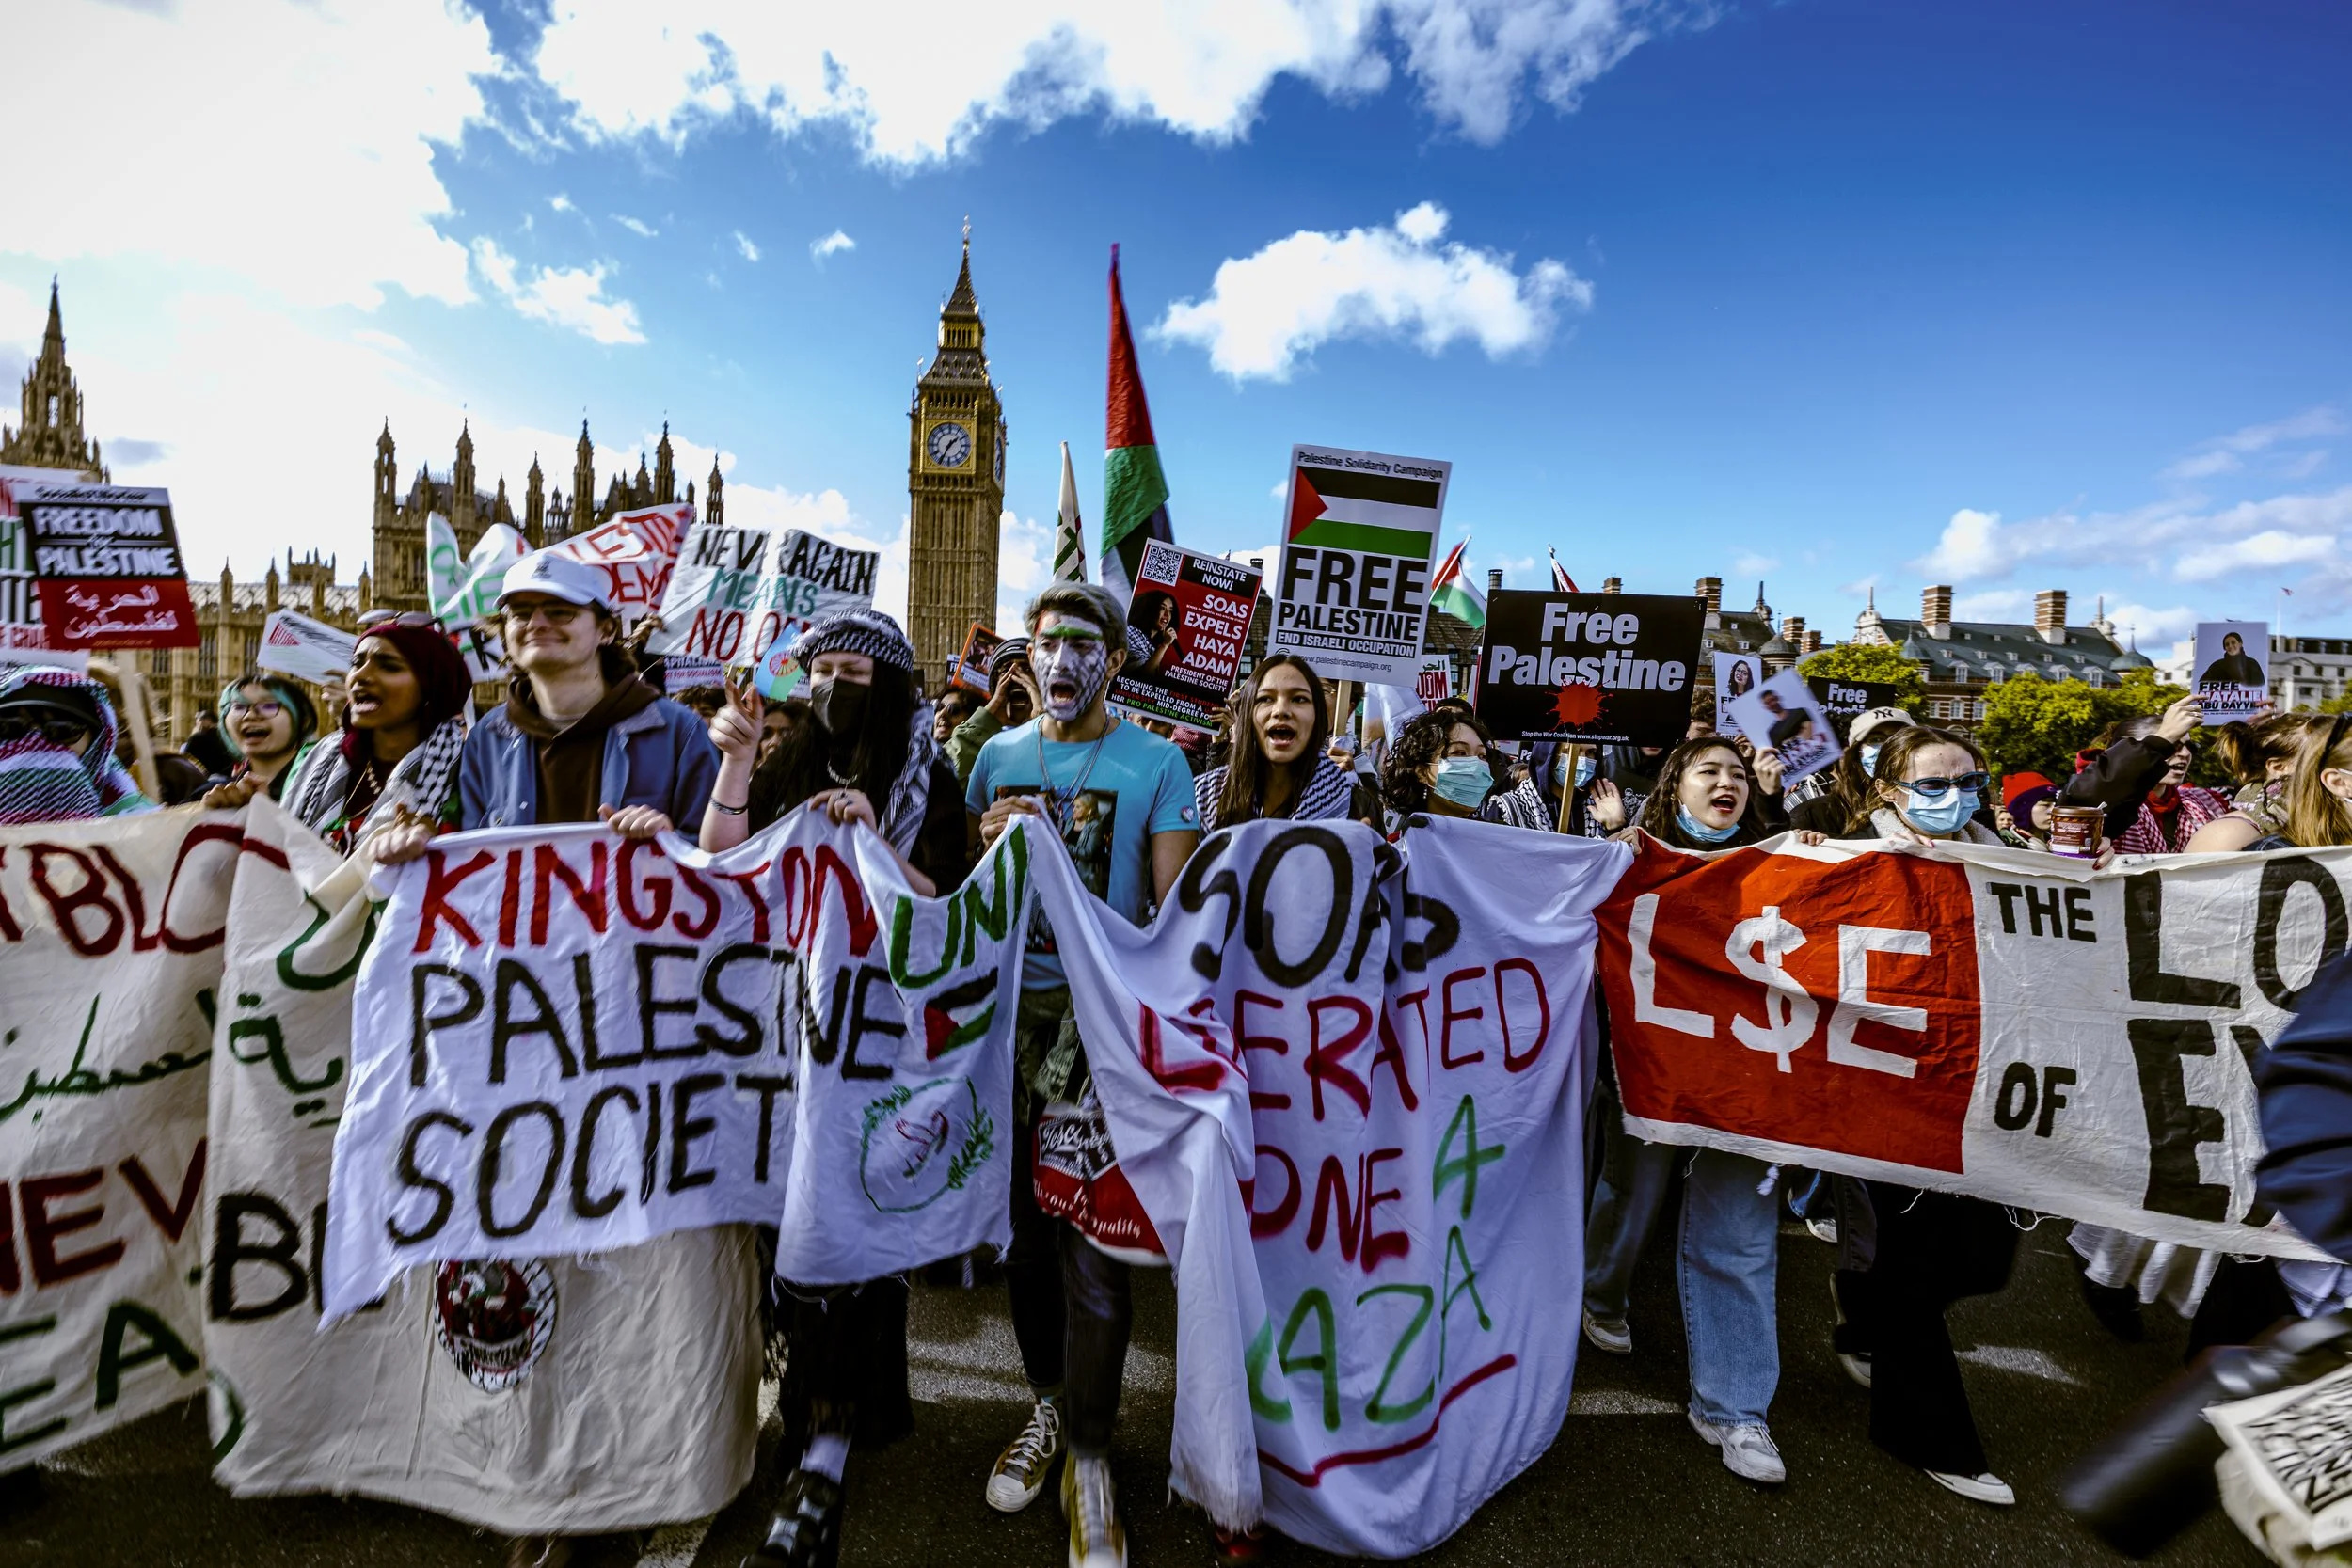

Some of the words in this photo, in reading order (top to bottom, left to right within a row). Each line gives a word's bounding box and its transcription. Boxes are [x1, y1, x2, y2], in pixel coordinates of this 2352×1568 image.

[1297, 451, 1343, 468] Palestine
[1345, 457, 1392, 474] Solidarity
[1393, 463, 1443, 480] Campaign
[32, 507, 164, 537] FREEDOM
[35, 546, 180, 577] PALESTINE
[787, 533, 876, 596] AGAIN
[1192, 558, 1247, 582] REINSTATE
[707, 567, 818, 617] MEANS
[1201, 574, 1234, 592] NOW!
[1281, 546, 1428, 614] FREE
[1202, 594, 1249, 619] SOAS
[1278, 602, 1421, 641] PALESTINE
[685, 607, 744, 661] NO
[1184, 611, 1243, 641] EXPELS
[1540, 602, 1639, 644] Free
[1193, 633, 1236, 658] HAYA
[1277, 631, 1300, 645] END
[1303, 634, 1345, 650] ISRAELI
[1348, 640, 1415, 657] OCCUPATION
[1170, 664, 1206, 679] PRESIDENT
[1206, 674, 1216, 683] OF
[1216, 677, 1229, 687] THE
[1182, 651, 1232, 677] ADAM
[1422, 659, 1446, 672] الحر
[1487, 645, 1686, 692] Palestine
[1116, 675, 1153, 690] BECOMING
[1155, 686, 1168, 696] THE
[1120, 683, 1130, 691] TO
[1131, 686, 1140, 694] BE
[1141, 689, 1174, 703] EXPELLED
[1175, 699, 1197, 709] FROM
[1165, 670, 1199, 685] PALESTINE
[1199, 680, 1227, 693] SOCIETY
[1828, 683, 1867, 704] Free
[2199, 681, 2240, 691] FREE
[1111, 693, 1125, 703] HER
[1126, 698, 1141, 707] PRO
[1142, 703, 1178, 718] PALESTINE
[1180, 714, 1213, 727] ACTIVISM
[1156, 701, 1199, 718] MID-DEGREE
[1200, 712, 1210, 721] FO
[1521, 730, 1534, 738] Stop
[1553, 731, 1577, 739] Coalition
[1577, 734, 1629, 742] www.stopwar.org.uk
[411, 841, 879, 956] KINGSTON
[1986, 880, 2098, 943] THE
[1627, 893, 1931, 1079] L$E
[1138, 957, 1551, 1122] LERATED
[1994, 1061, 2077, 1138] OF
[387, 1072, 794, 1246] SOCIET
[1238, 1144, 1410, 1274] ONE
